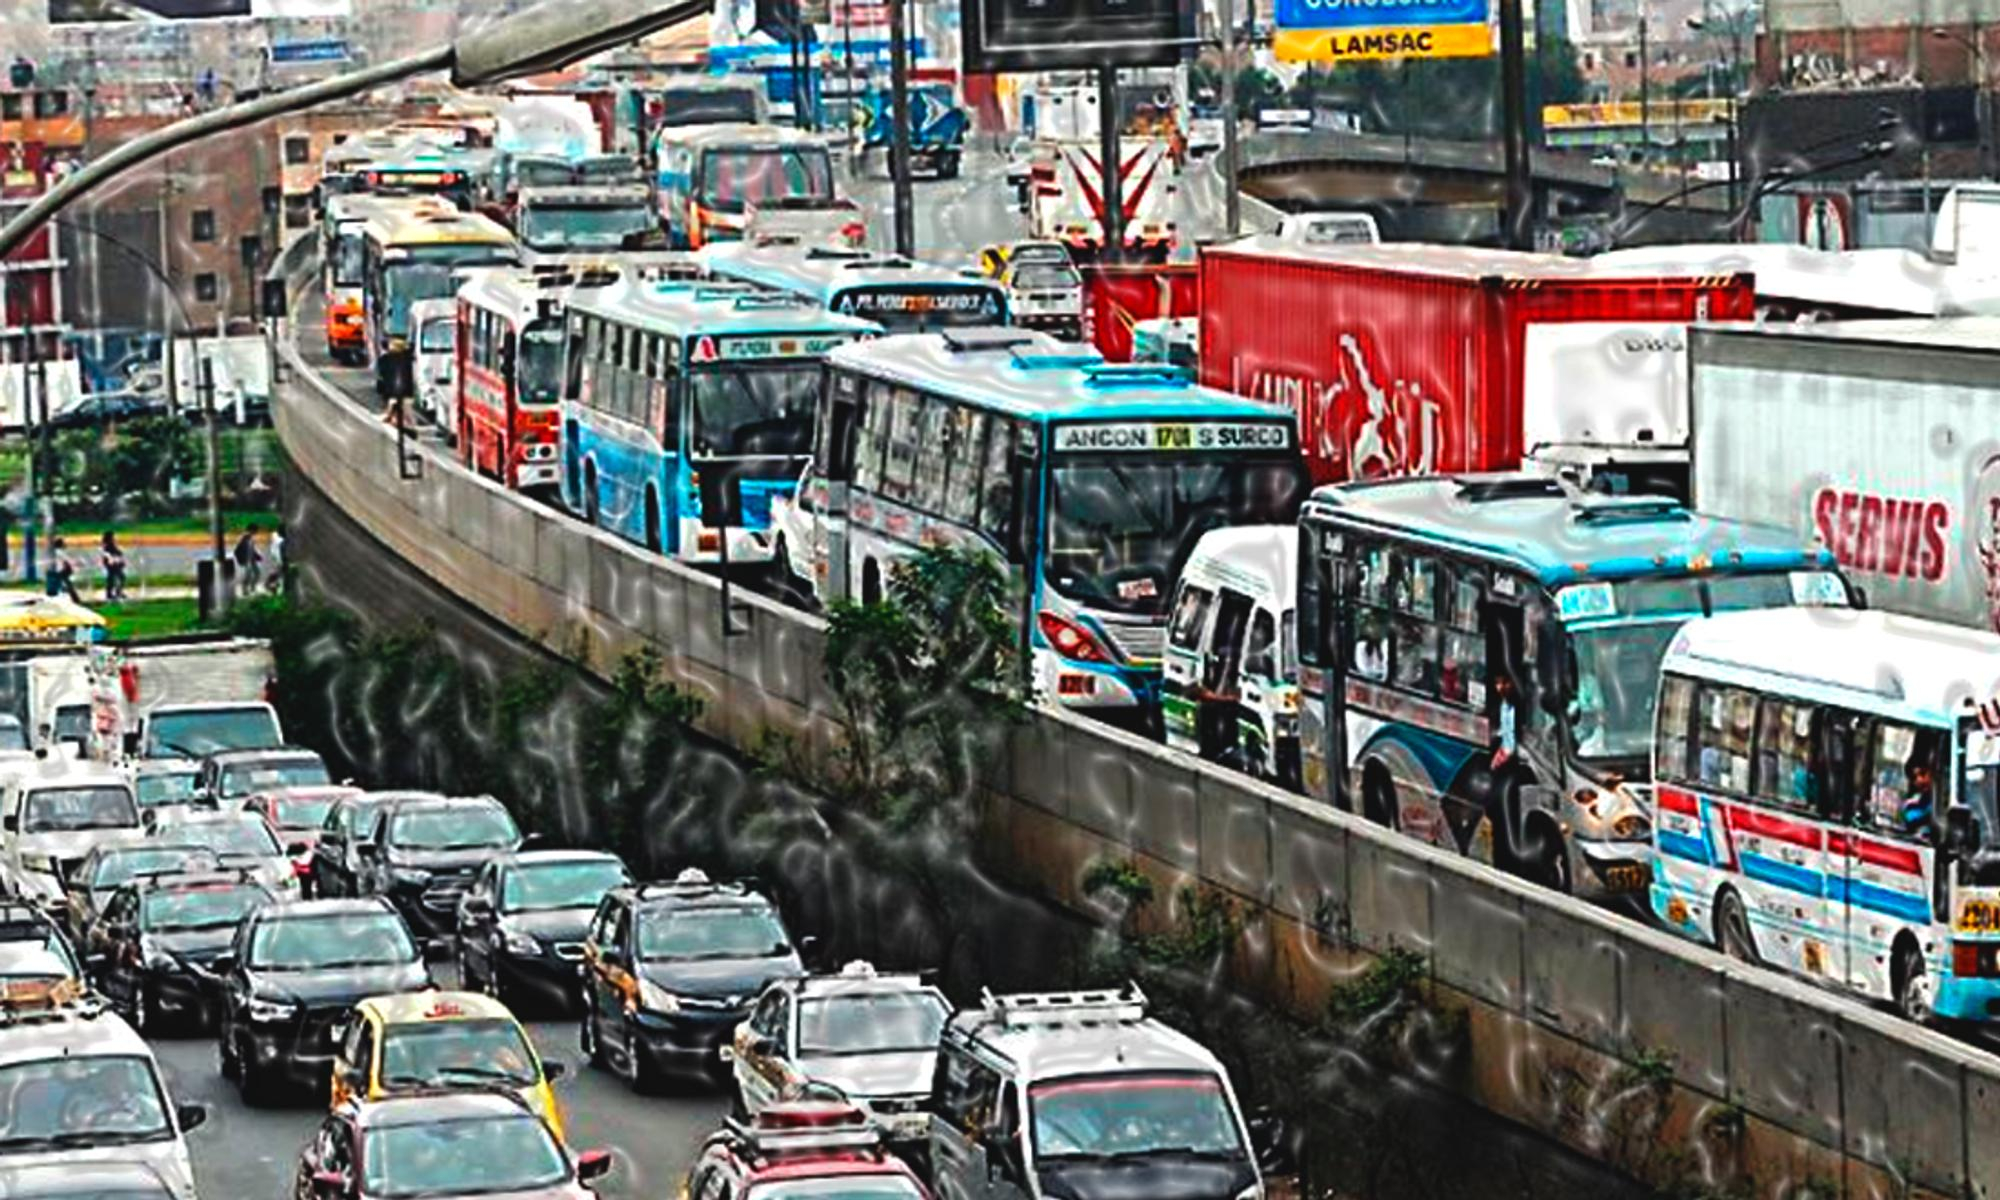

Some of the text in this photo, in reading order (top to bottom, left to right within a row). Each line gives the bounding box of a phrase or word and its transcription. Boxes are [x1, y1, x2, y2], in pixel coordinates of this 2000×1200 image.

[1329, 32, 1433, 55] LAMSAC
[1065, 428, 1147, 448] ANCON
[1217, 426, 1284, 447] SURCO
[1814, 488, 1949, 583] SERVIS
